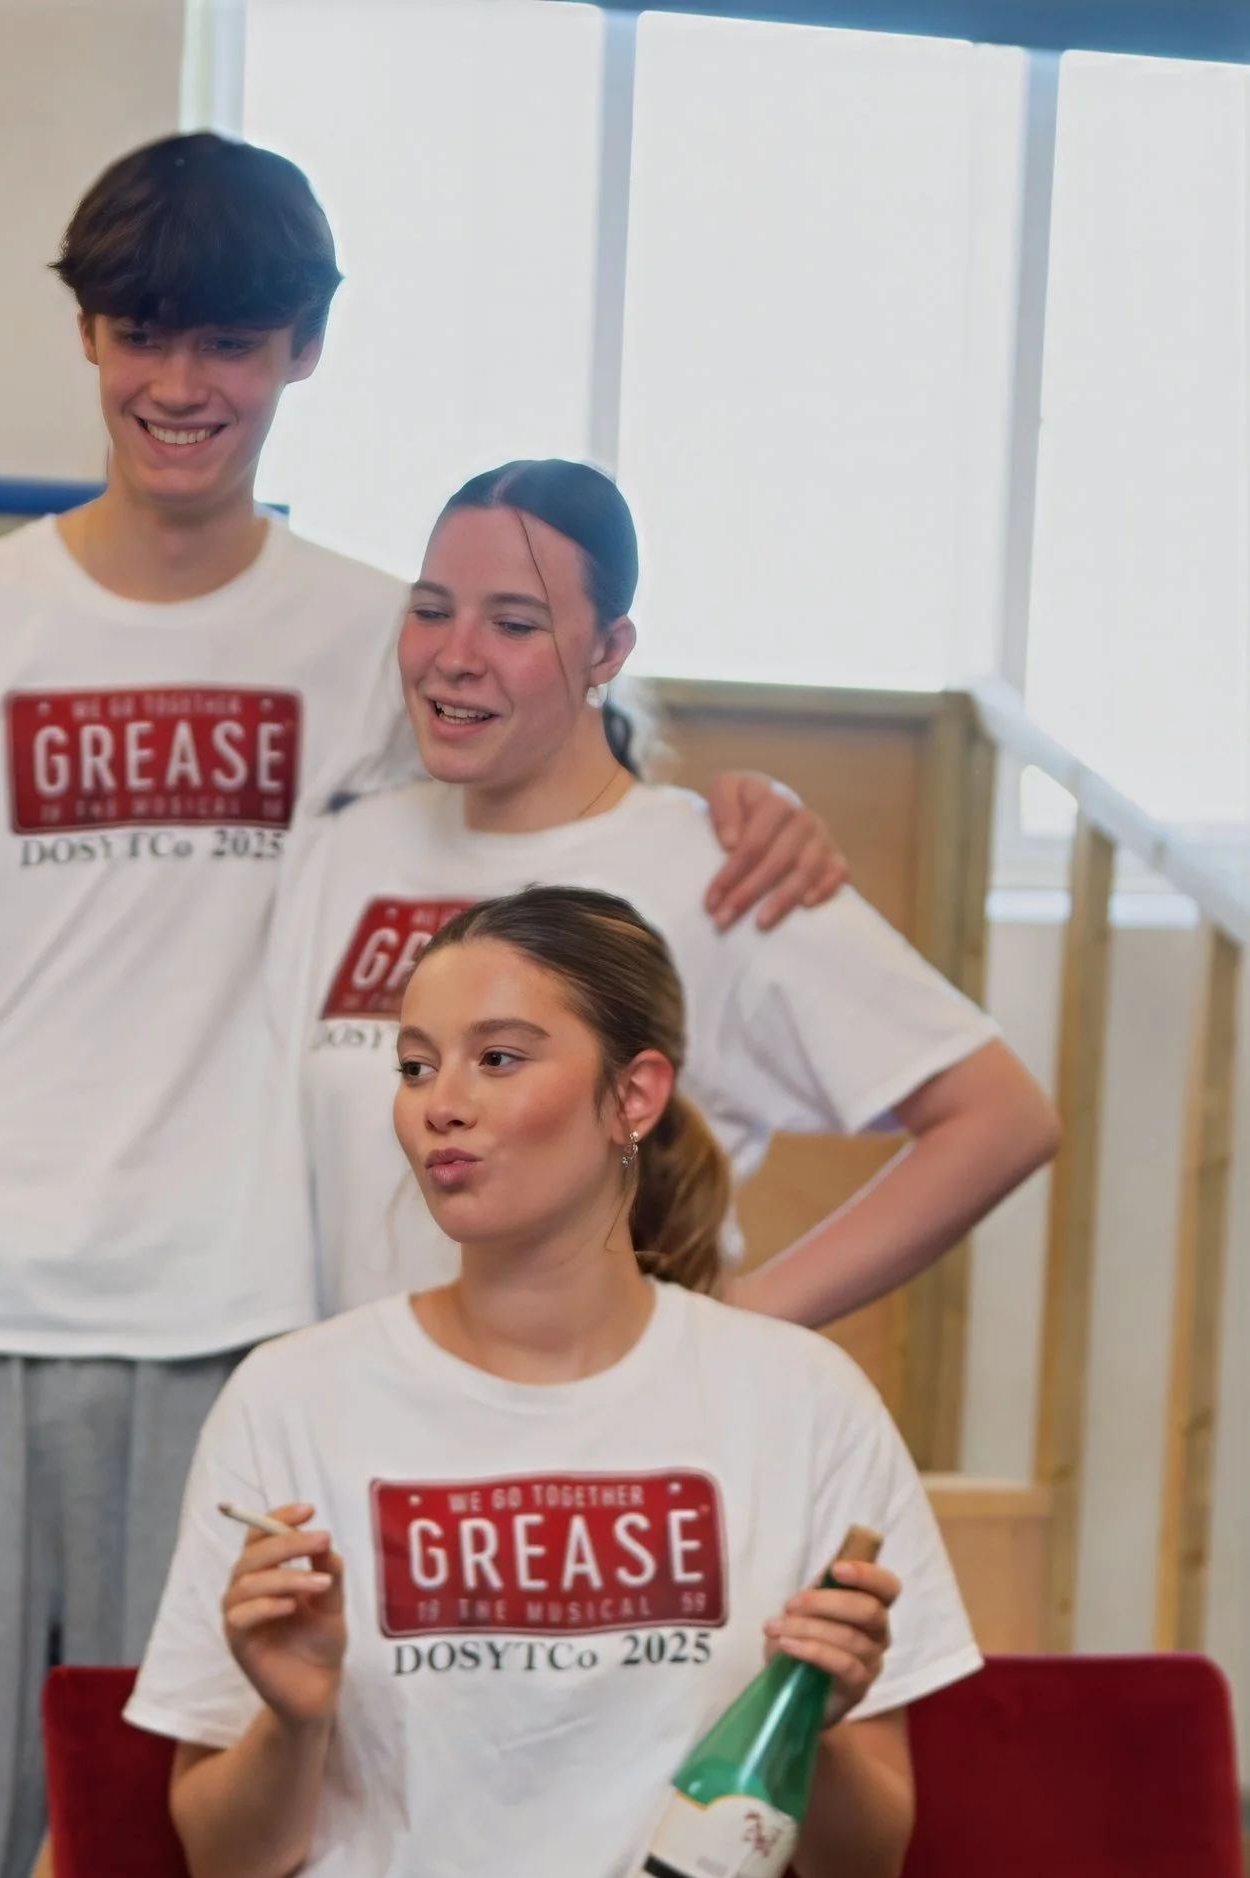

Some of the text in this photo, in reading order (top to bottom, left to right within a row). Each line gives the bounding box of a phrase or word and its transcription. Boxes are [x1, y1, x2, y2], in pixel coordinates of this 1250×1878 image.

[33, 719, 285, 798] GREASE
[210, 829, 285, 860] 2025
[448, 1484, 645, 1513] WE GO TOGETHER
[408, 1509, 704, 1592] GREASE
[458, 1598, 507, 1621] THE
[526, 1595, 652, 1624] MUSICAL
[393, 1631, 712, 1676] DOSYTCo 2025
